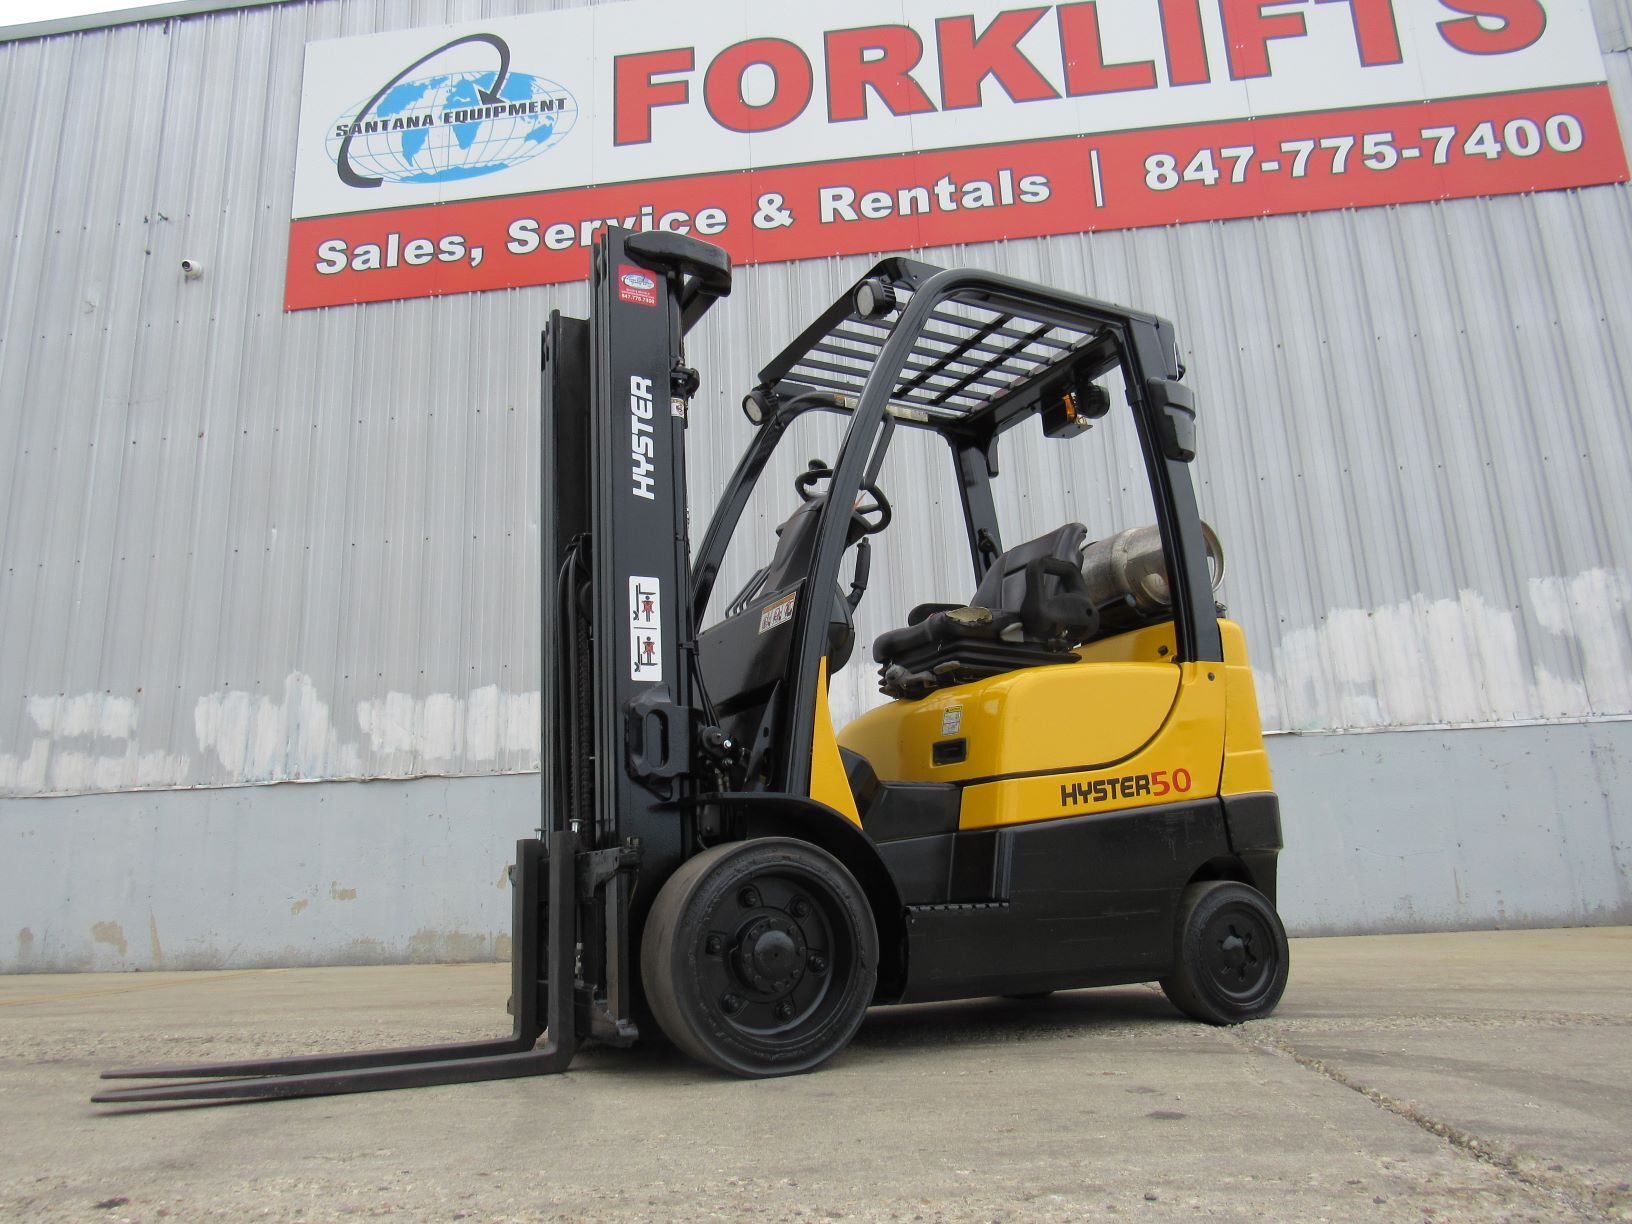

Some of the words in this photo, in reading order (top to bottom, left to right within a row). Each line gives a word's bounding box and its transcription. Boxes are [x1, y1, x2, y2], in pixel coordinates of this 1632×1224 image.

[336, 113, 435, 137] SANTANA
[443, 98, 567, 124] EQUIPMENT
[315, 233, 484, 275] Sales,
[752, 192, 795, 229] &
[819, 168, 1051, 225] Rentals
[1143, 112, 1584, 191] 847-775-7400
[630, 375, 655, 501] HYSTER
